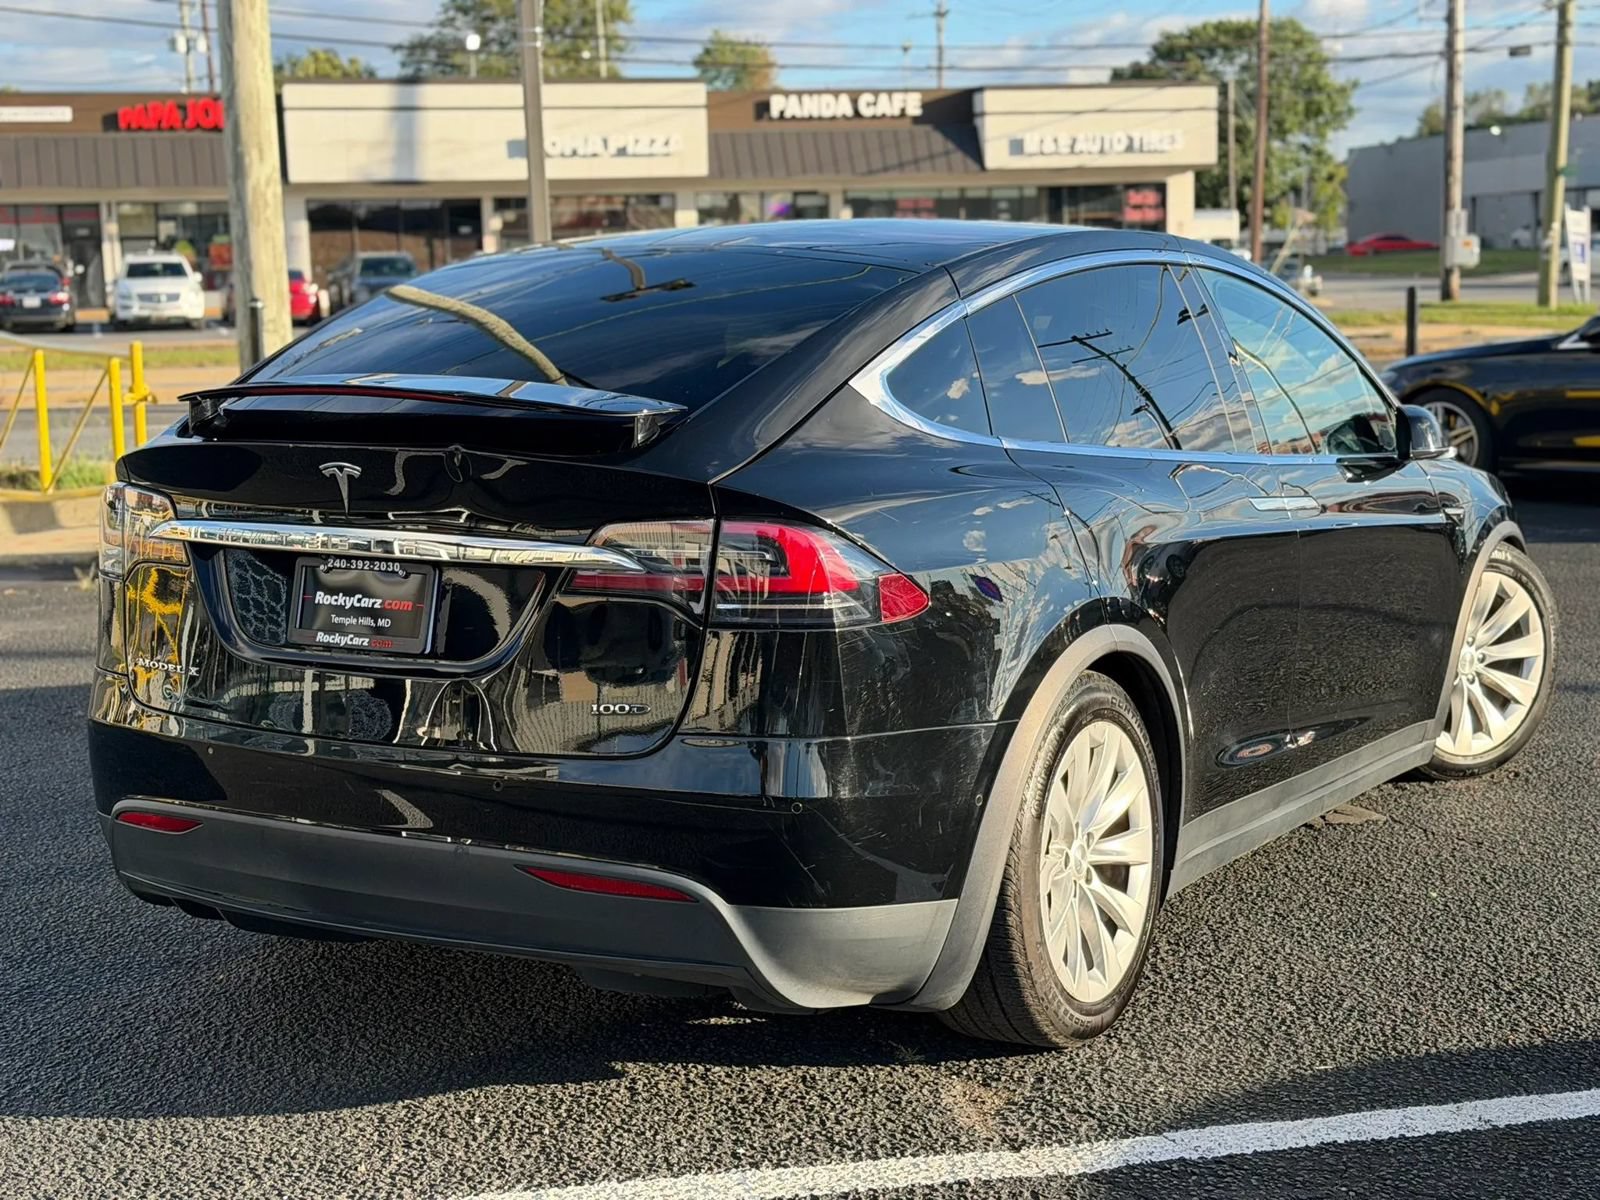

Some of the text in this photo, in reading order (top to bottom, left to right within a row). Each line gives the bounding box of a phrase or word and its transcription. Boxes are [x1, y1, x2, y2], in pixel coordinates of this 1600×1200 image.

[117, 100, 182, 129] PAPA
[769, 92, 923, 119] PANDA CAFE
[1075, 130, 1127, 153] AUTO
[327, 558, 400, 572] 240-392-2030
[331, 614, 392, 628] Temple Hills, MD
[137, 658, 200, 677] MODEL X
[591, 703, 651, 715] 100D
